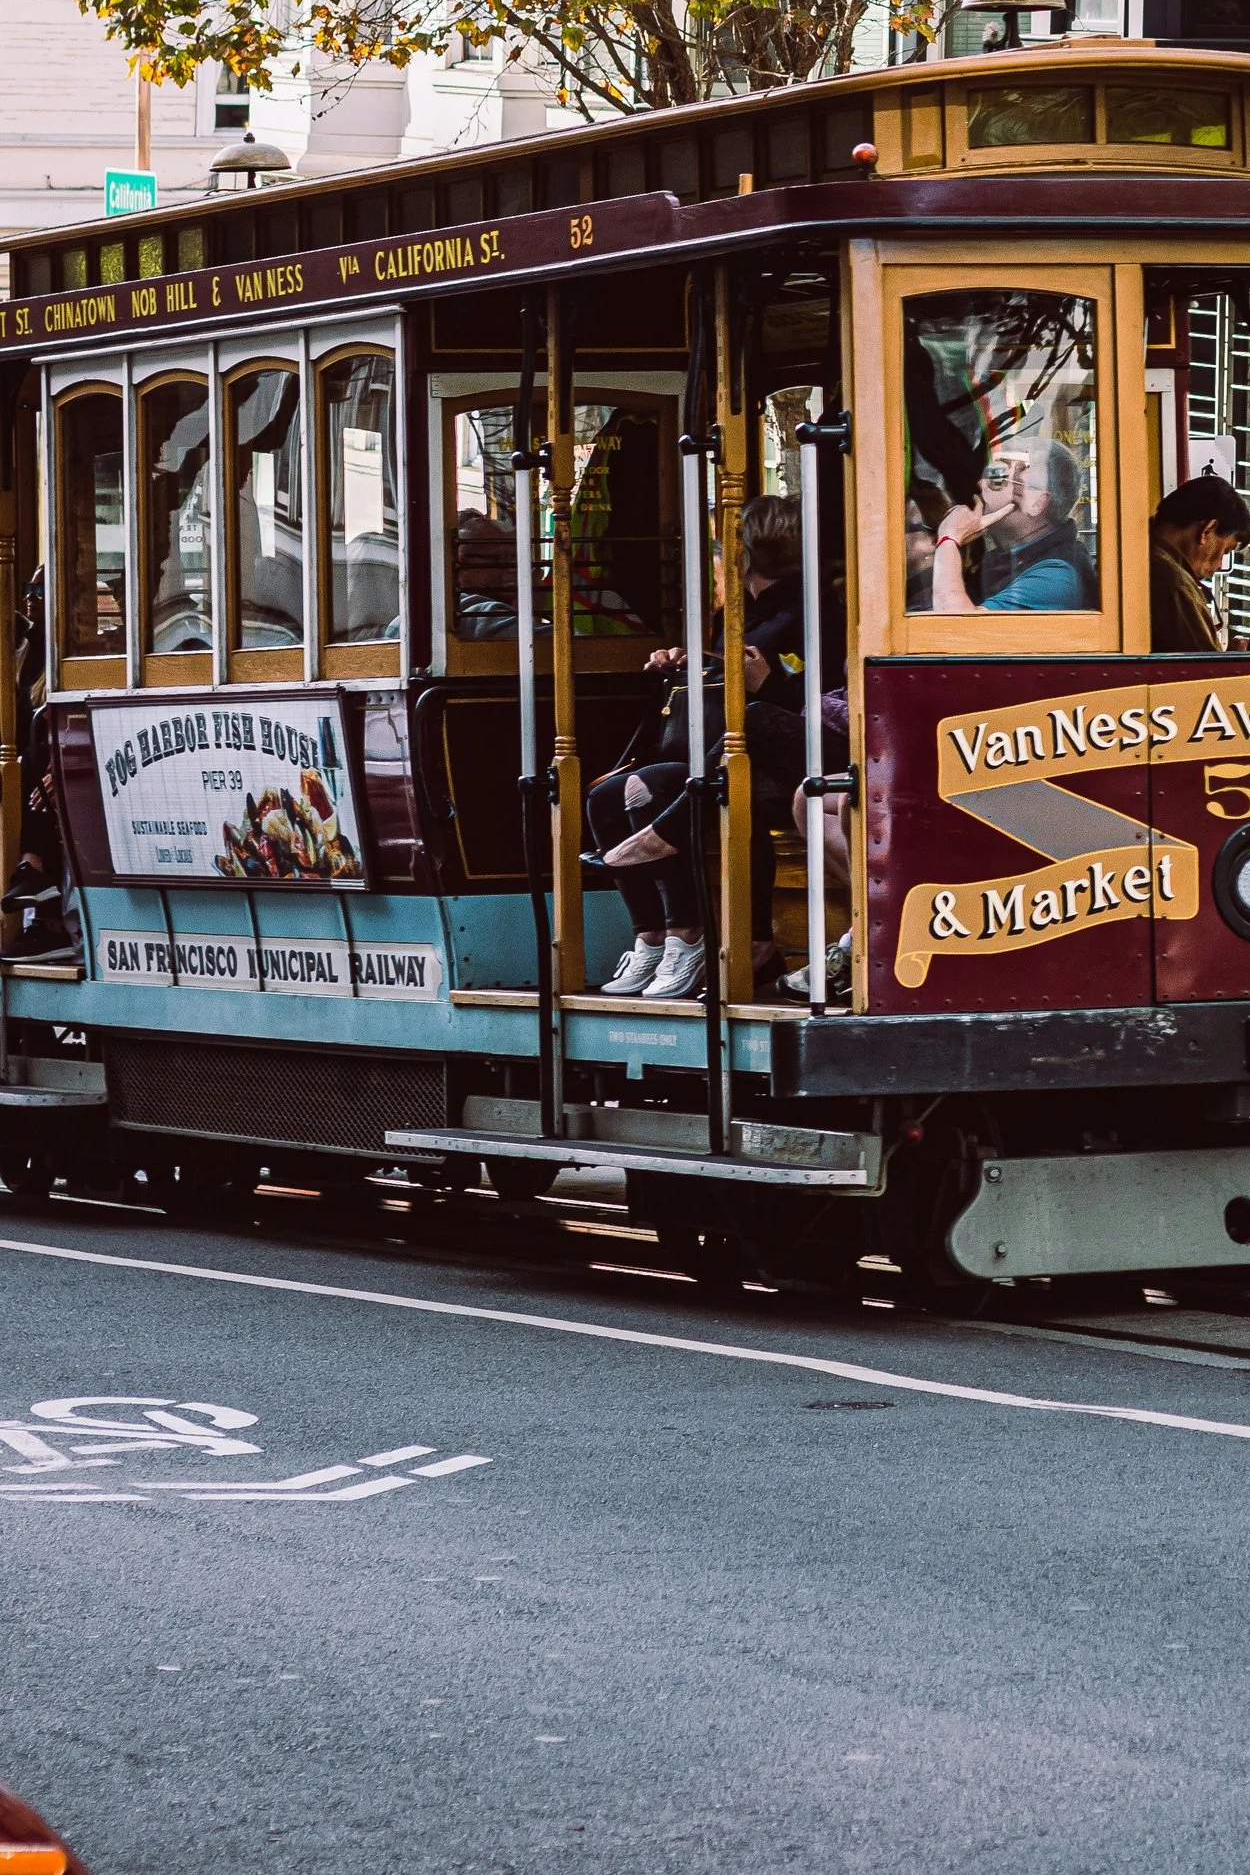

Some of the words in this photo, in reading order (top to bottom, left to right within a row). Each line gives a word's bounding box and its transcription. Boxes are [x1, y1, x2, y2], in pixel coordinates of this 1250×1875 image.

[109, 180, 152, 211] California
[44, 295, 116, 332] CHINATOWN
[131, 287, 157, 318] NOB
[166, 282, 197, 313] HILL
[212, 276, 221, 307] &
[235, 271, 263, 303] VAN
[266, 263, 304, 298] NESS
[339, 255, 361, 285] VIA
[374, 237, 475, 281] CALIFORNIA
[570, 214, 594, 249] 52
[105, 740, 137, 797] FOG
[137, 712, 210, 768] HARBOR
[212, 711, 257, 751] FISH
[259, 715, 321, 770] HOUSE
[948, 722, 1046, 775] Van
[1048, 704, 1179, 758] Ness
[202, 770, 226, 790] PIER
[228, 770, 243, 790] 39
[931, 890, 972, 940] &
[977, 854, 1176, 940] Market
[107, 939, 141, 972] SAN
[247, 948, 339, 983] MUNICIPAL
[348, 952, 426, 987] RAILWAY
